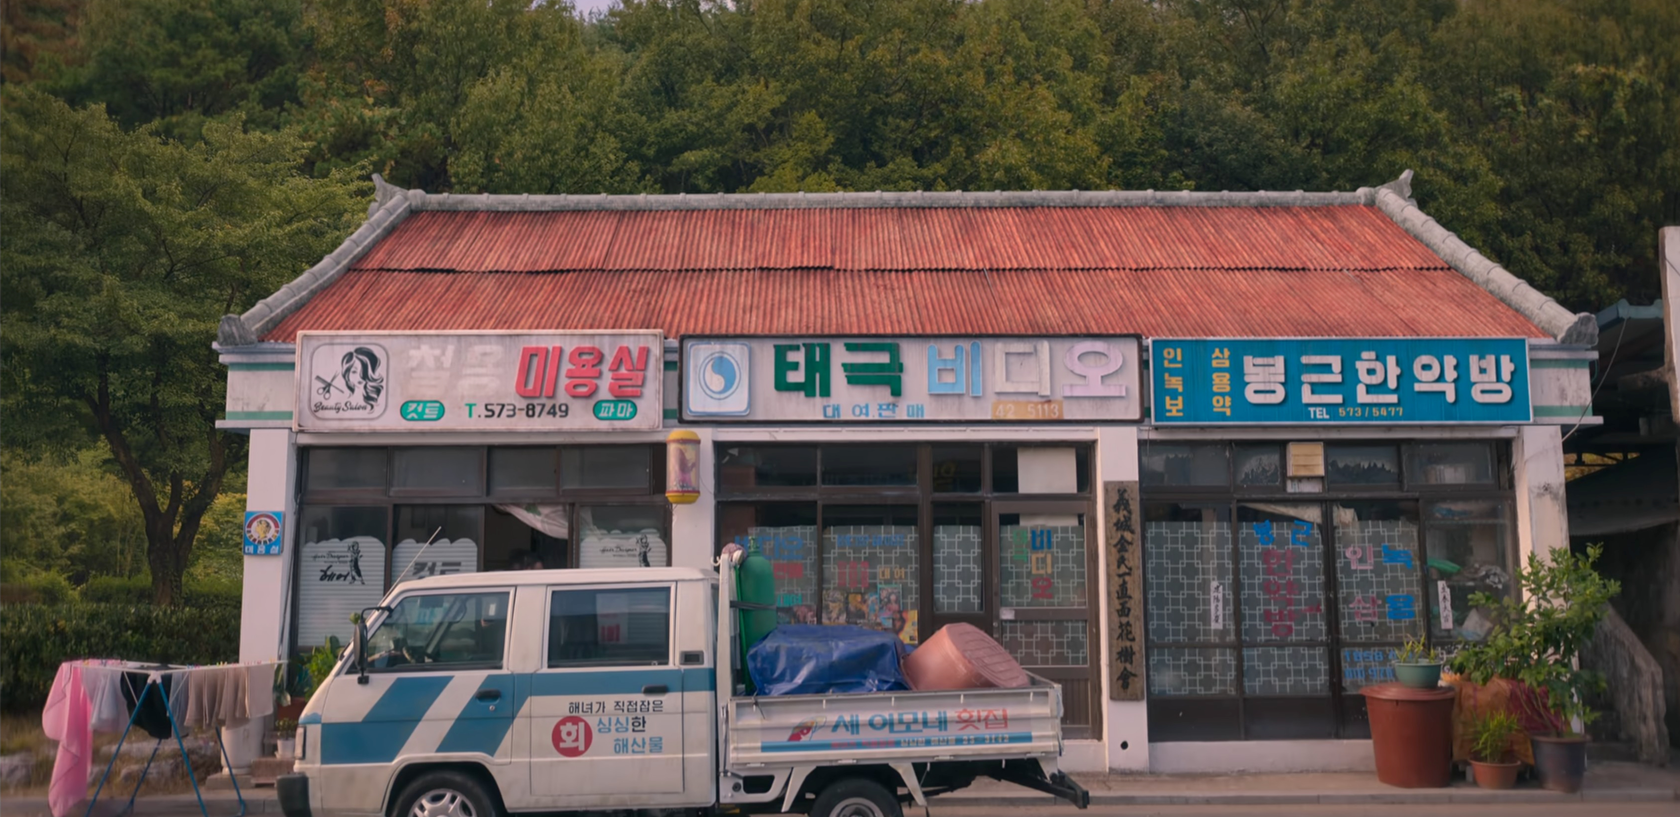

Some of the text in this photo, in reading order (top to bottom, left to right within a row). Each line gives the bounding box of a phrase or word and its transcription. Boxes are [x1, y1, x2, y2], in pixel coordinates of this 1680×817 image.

[514, 346, 649, 398] 미용실
[774, 339, 1127, 398] 태극 비디오
[1243, 351, 1515, 405] 봉근한약방
[313, 401, 341, 414] Beauty
[599, 403, 633, 417] 파마
[1308, 407, 1329, 419] TEL
[244, 545, 279, 554] 미용실
[1031, 529, 1053, 599] 비디오
[1262, 548, 1300, 637] 한약방
[569, 700, 664, 714] 해녀가 직접잡은
[597, 716, 646, 733] 싱싱한
[831, 708, 1009, 735] 세 이모네 횟집
[559, 722, 585, 751] 회
[614, 736, 663, 754] 해산물
